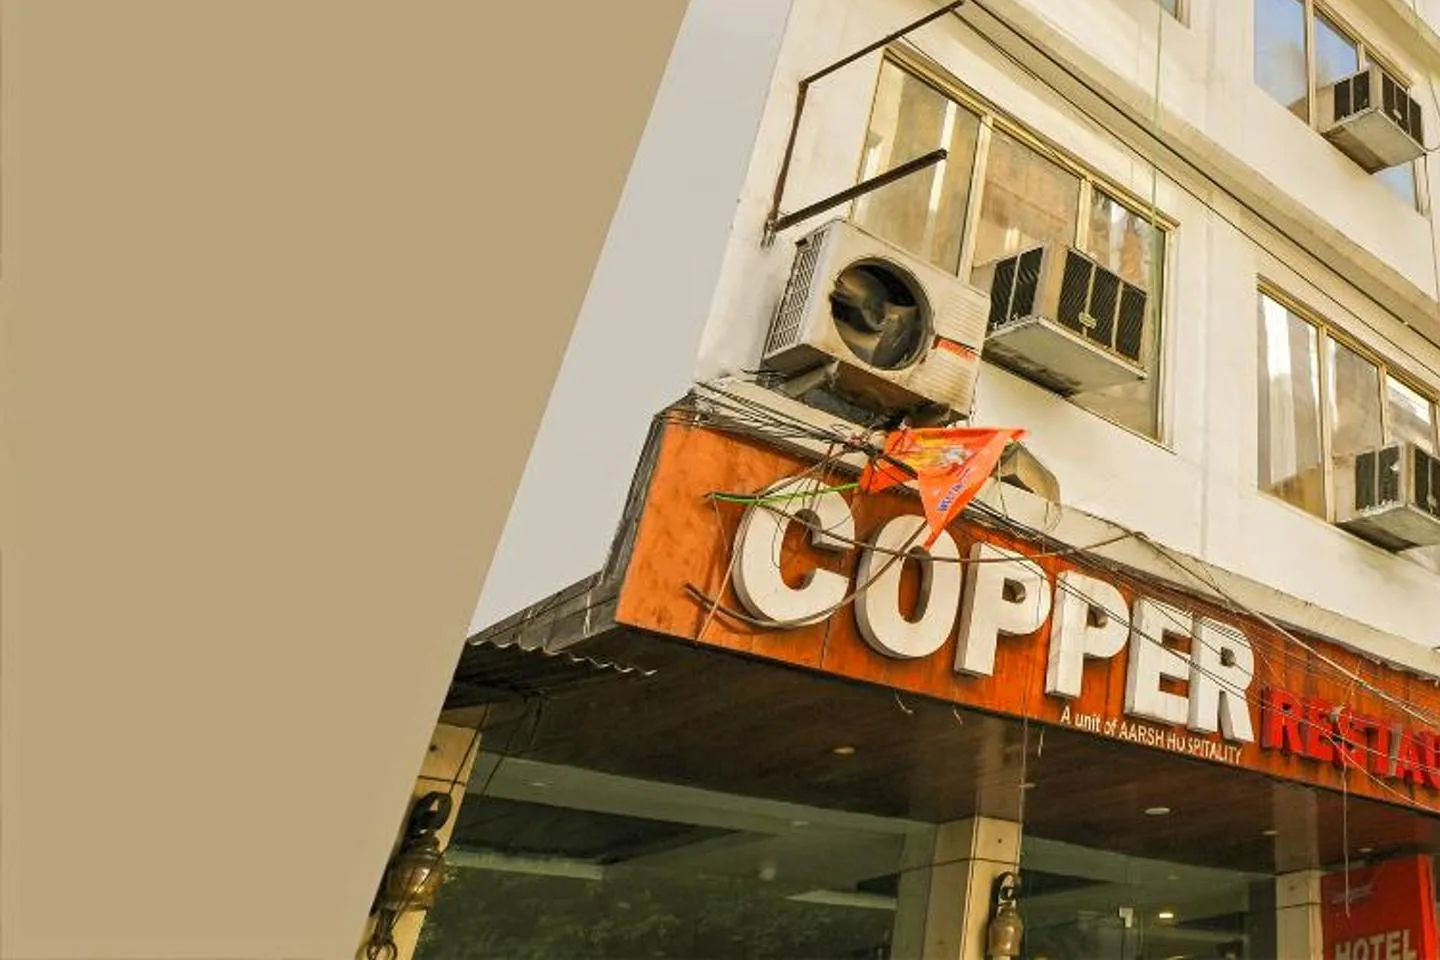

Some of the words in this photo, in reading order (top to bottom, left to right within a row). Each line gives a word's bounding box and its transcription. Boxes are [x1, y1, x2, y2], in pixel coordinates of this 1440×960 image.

[733, 475, 1255, 741] COPPER
[1060, 705, 1072, 725] A
[1075, 713, 1101, 733] unit
[1103, 719, 1117, 736] of
[1119, 721, 1165, 748] AARSH
[1335, 929, 1418, 960] HOTEL
